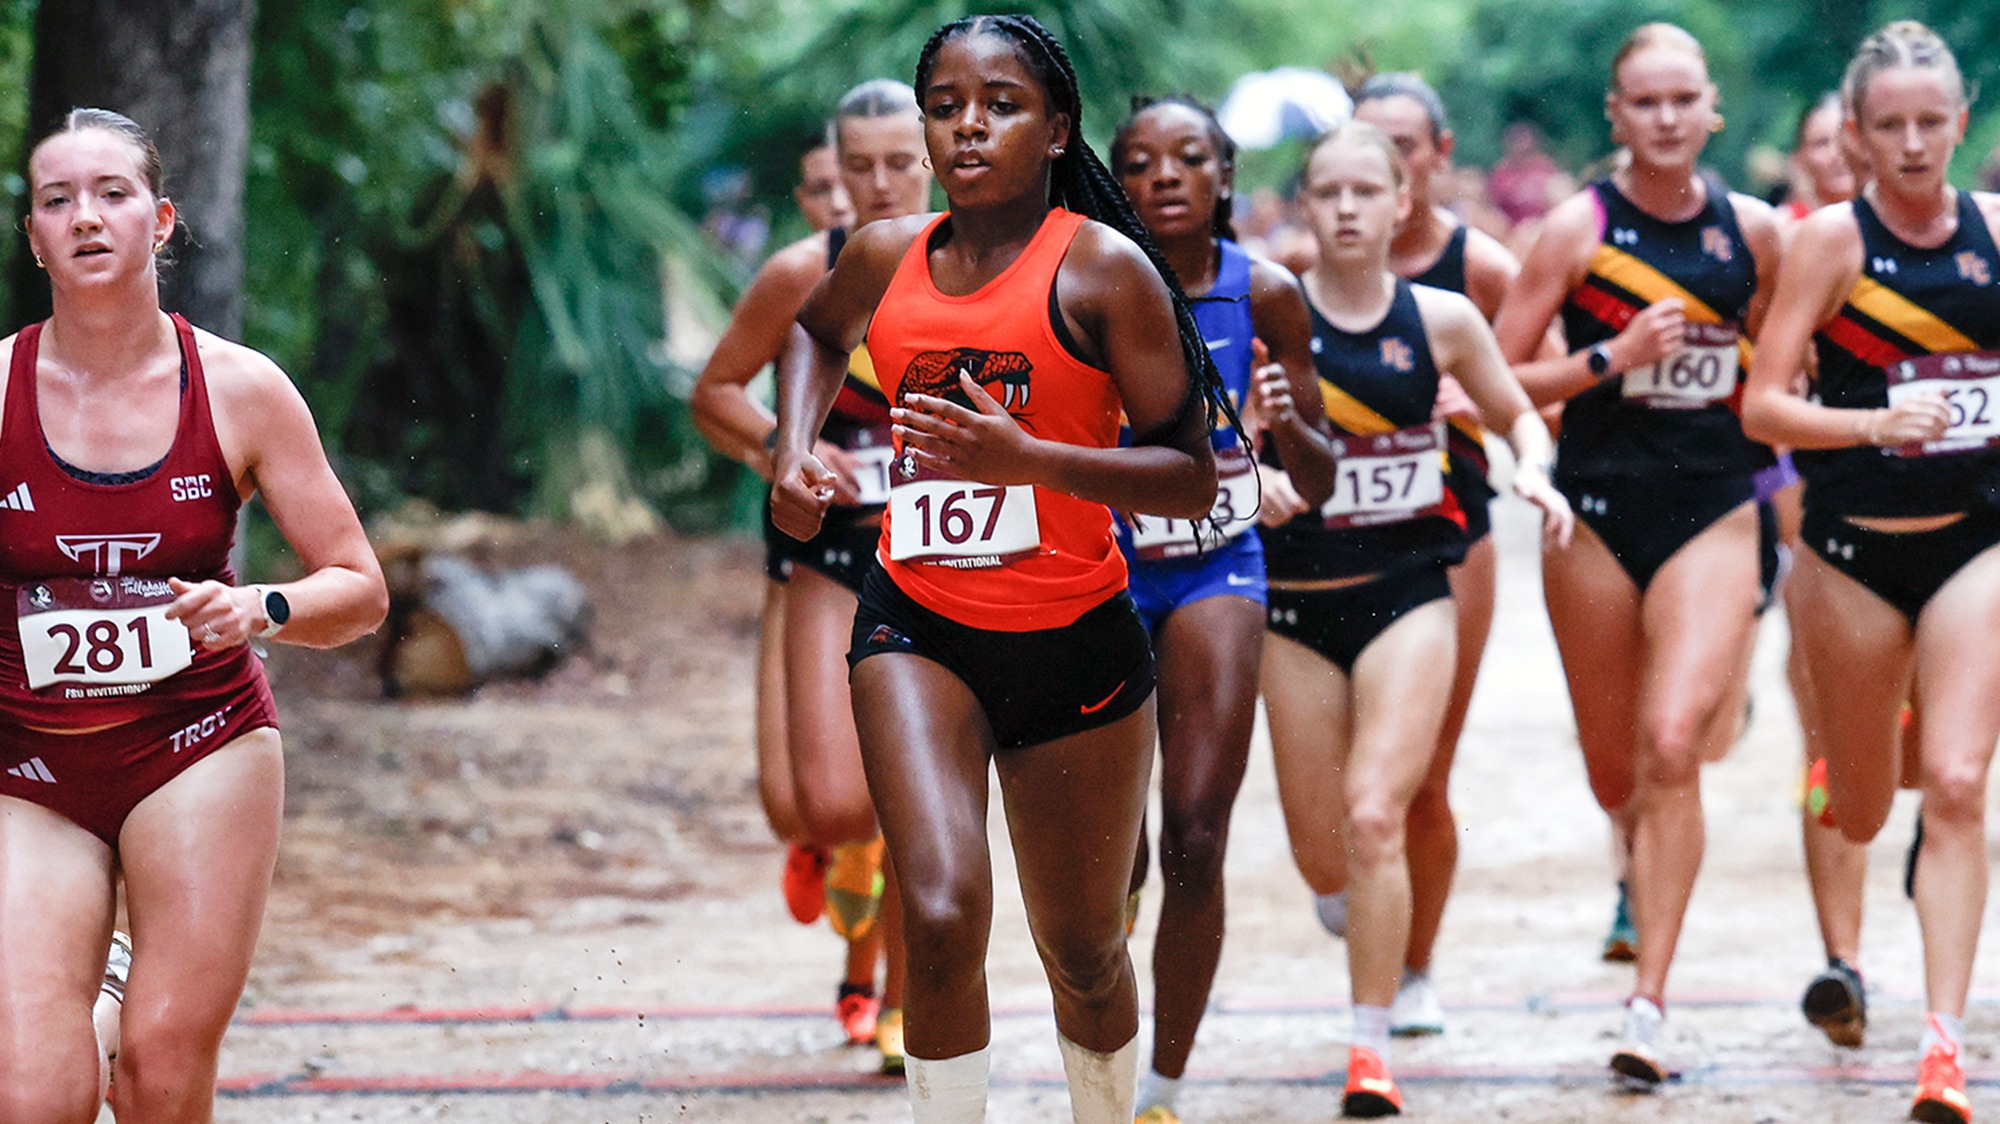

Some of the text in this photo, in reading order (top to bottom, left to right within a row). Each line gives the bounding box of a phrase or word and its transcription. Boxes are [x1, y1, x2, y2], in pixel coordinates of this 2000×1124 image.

[1651, 353, 1721, 388] 160
[1943, 387, 1990, 427] 62
[170, 474, 213, 502] SBC
[1345, 461, 1418, 504] 157
[914, 487, 1008, 547] 167
[46, 615, 153, 675] 281
[65, 682, 151, 700] FSU INVITATIONA
[169, 705, 232, 753] TROY
